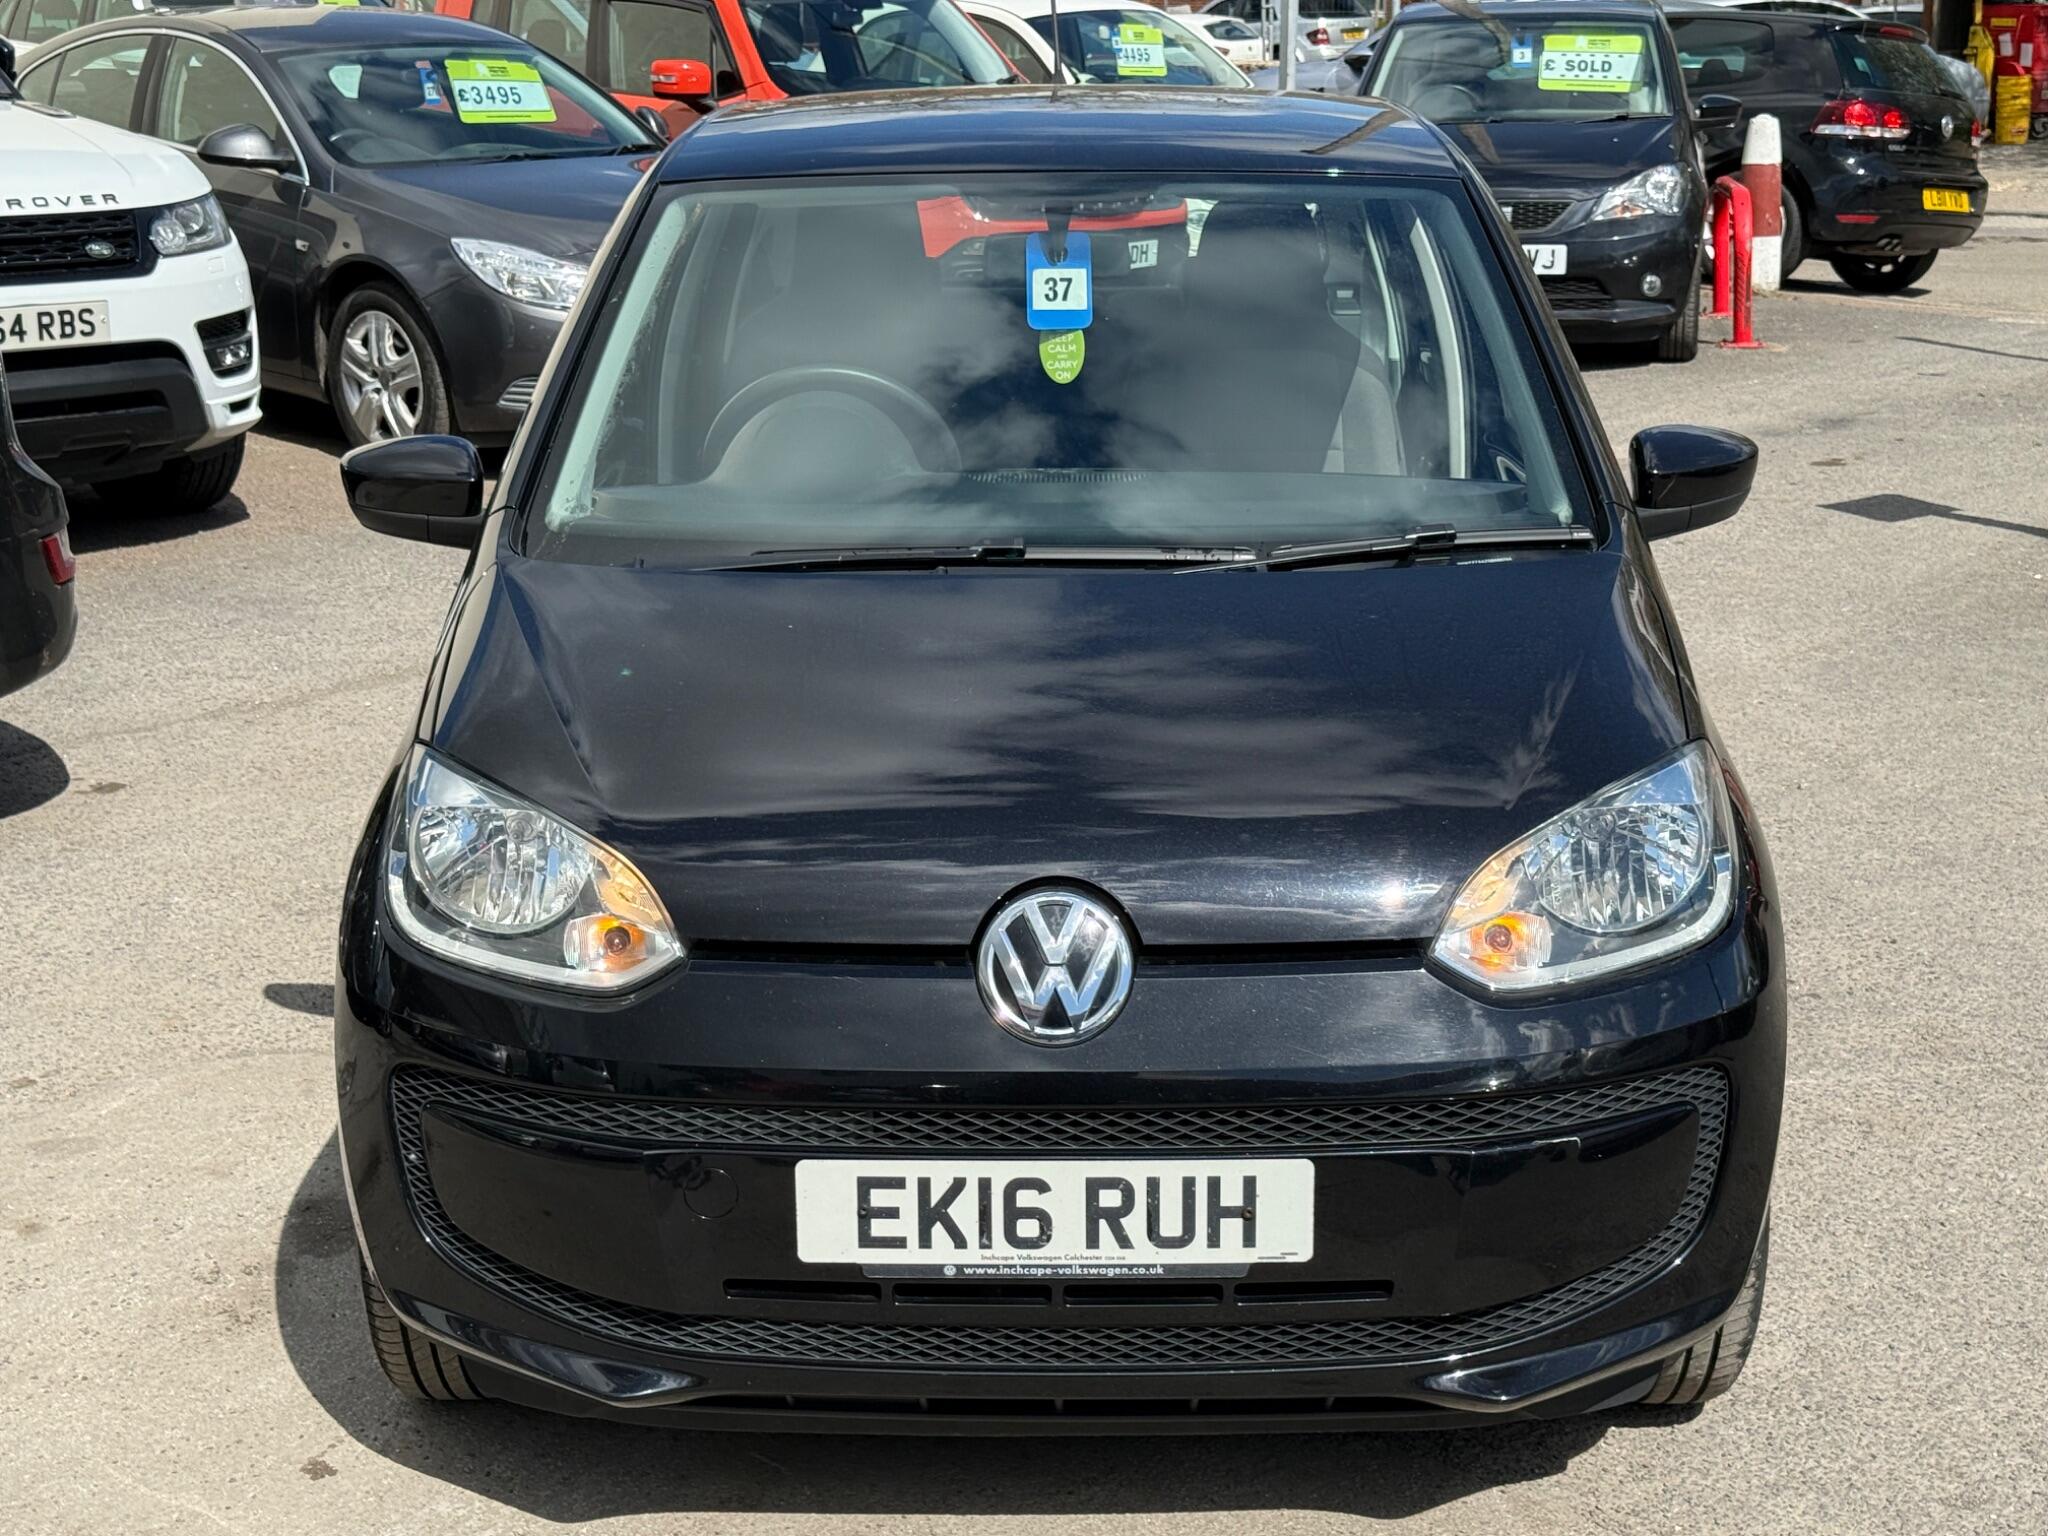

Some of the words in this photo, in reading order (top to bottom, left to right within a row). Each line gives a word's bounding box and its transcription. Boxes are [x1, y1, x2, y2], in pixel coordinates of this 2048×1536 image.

[1117, 47, 1151, 62] 4495
[1543, 59, 1556, 71] £
[1564, 59, 1612, 73] SOLD
[457, 85, 522, 105] £3495
[5, 193, 120, 210] ROVER
[1044, 277, 1073, 302] 37
[37, 307, 96, 342] RBS
[1047, 343, 1077, 354] CALM
[1046, 359, 1078, 370] CARRY
[1055, 370, 1072, 380] ON
[856, 1176, 1053, 1250] EK16
[1084, 1175, 1257, 1250] RUH
[980, 1253, 1015, 1262] Inchcape
[1016, 1253, 1063, 1262] Volkswagen
[1064, 1253, 1103, 1261] Colchester
[963, 1264, 1165, 1276] www.inchcape-volkswagen.co.uk
